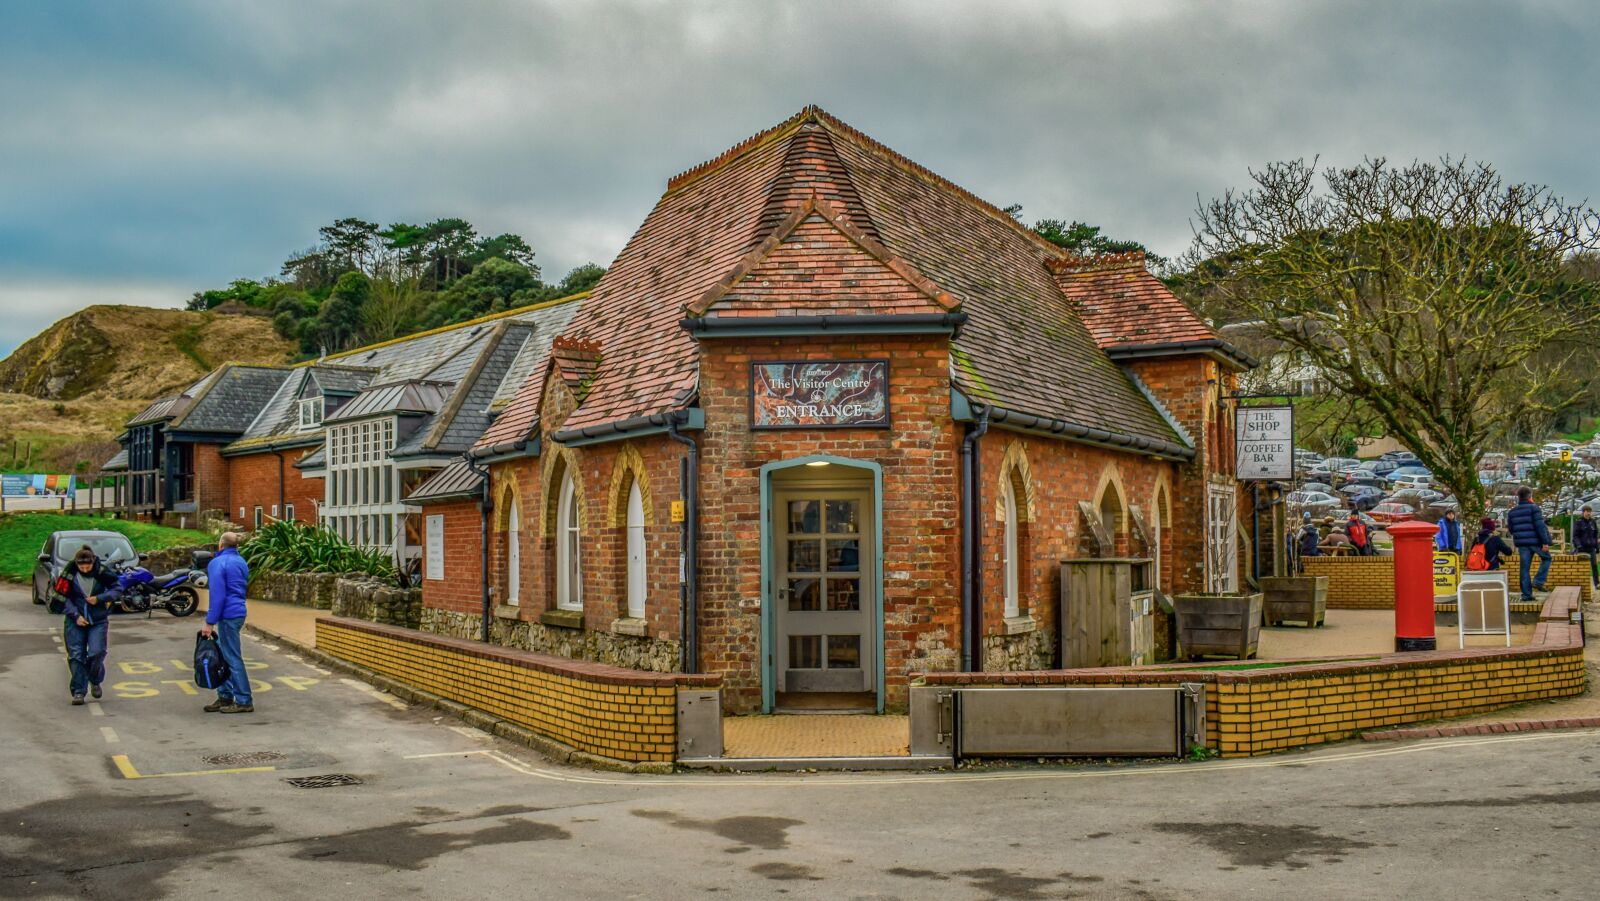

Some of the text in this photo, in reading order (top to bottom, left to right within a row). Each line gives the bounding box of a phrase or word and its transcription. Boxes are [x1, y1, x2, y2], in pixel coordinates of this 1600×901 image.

[769, 377, 870, 389] The Visitor Centre
[776, 404, 863, 418] ENTRANCE
[1254, 412, 1275, 420] THE
[1248, 421, 1280, 431] SHOP
[1260, 432, 1267, 441] &
[1244, 443, 1284, 453] COFFEE
[1253, 453, 1274, 462] BAR
[1561, 451, 1569, 460] P
